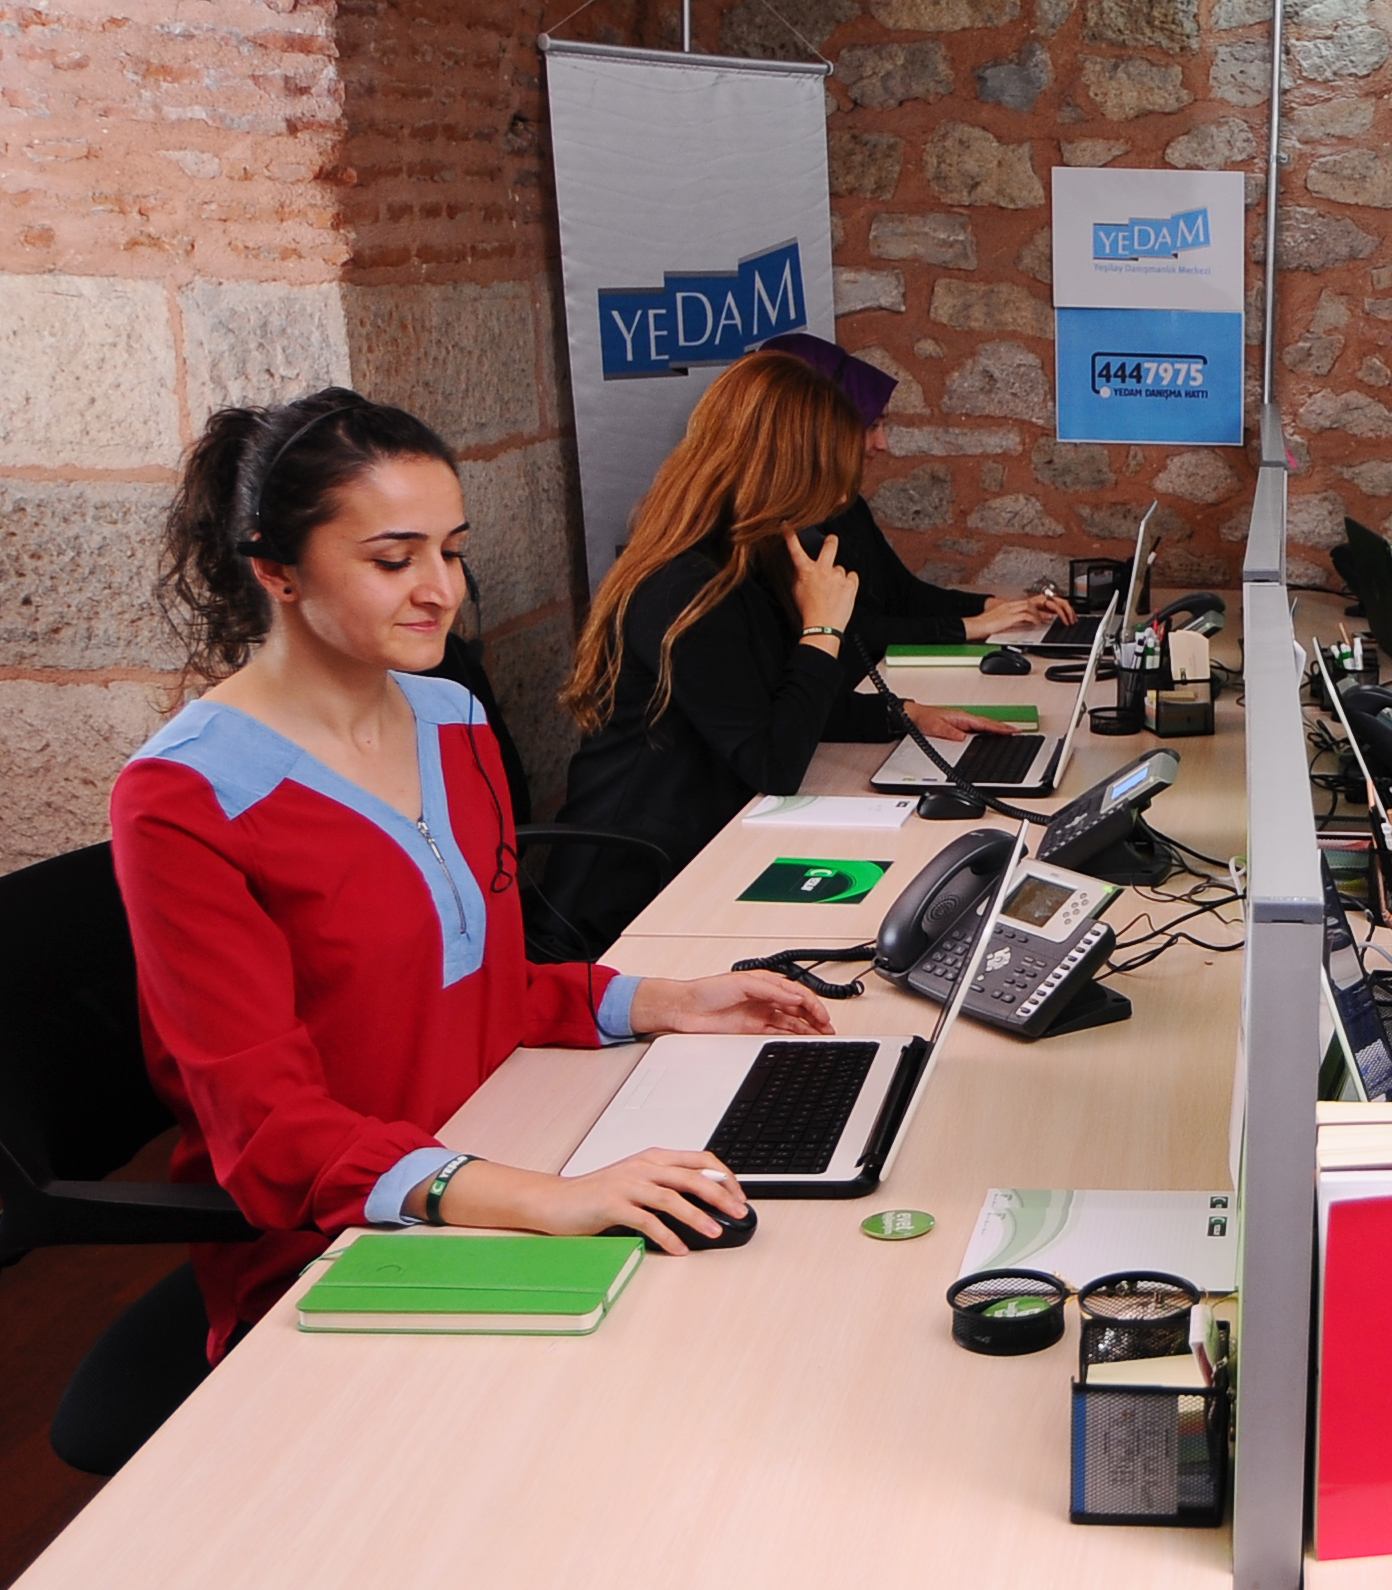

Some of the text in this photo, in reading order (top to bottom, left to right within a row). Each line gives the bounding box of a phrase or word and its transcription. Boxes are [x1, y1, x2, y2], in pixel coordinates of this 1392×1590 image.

[1099, 213, 1205, 255] YEDAM
[1179, 266, 1211, 275] Merkezi
[610, 258, 797, 362] YEDAM
[1097, 361, 1204, 387] 4447975
[1114, 388, 1209, 401] YEDAM DANIŞMA HATTI
